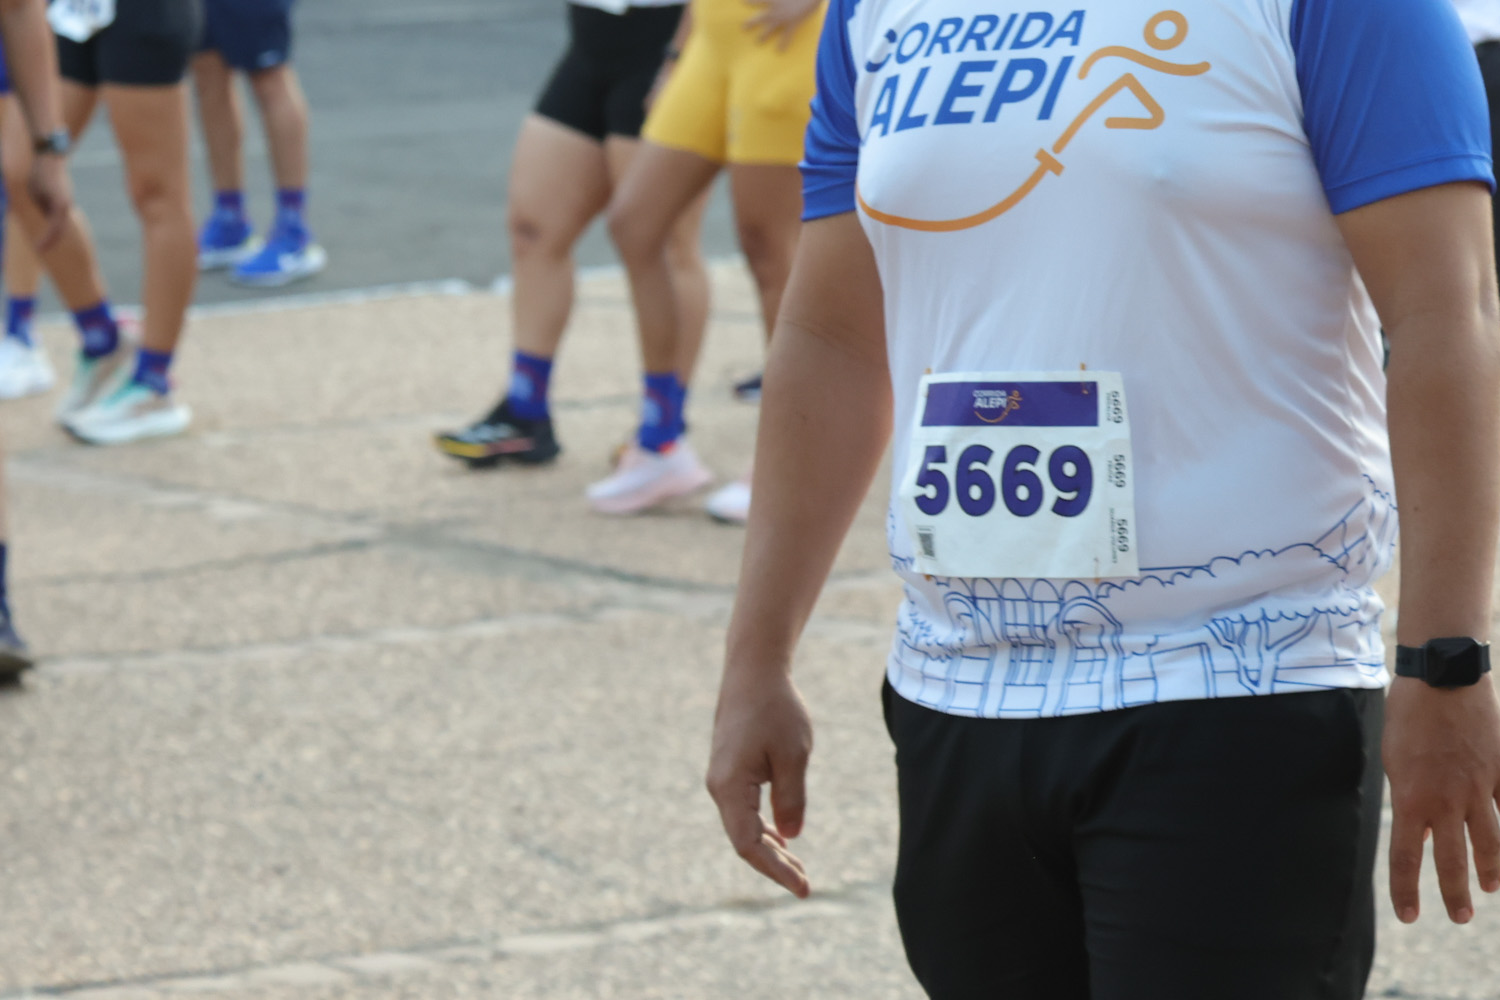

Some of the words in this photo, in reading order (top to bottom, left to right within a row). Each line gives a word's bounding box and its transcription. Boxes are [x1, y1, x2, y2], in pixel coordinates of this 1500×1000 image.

[865, 10, 1086, 73] CORRIDA
[862, 55, 1075, 146] ALEPI
[1111, 390, 1123, 424] 5669
[914, 444, 1093, 517] 5669
[1113, 453, 1126, 488] 5669
[1117, 518, 1129, 553] 5669
